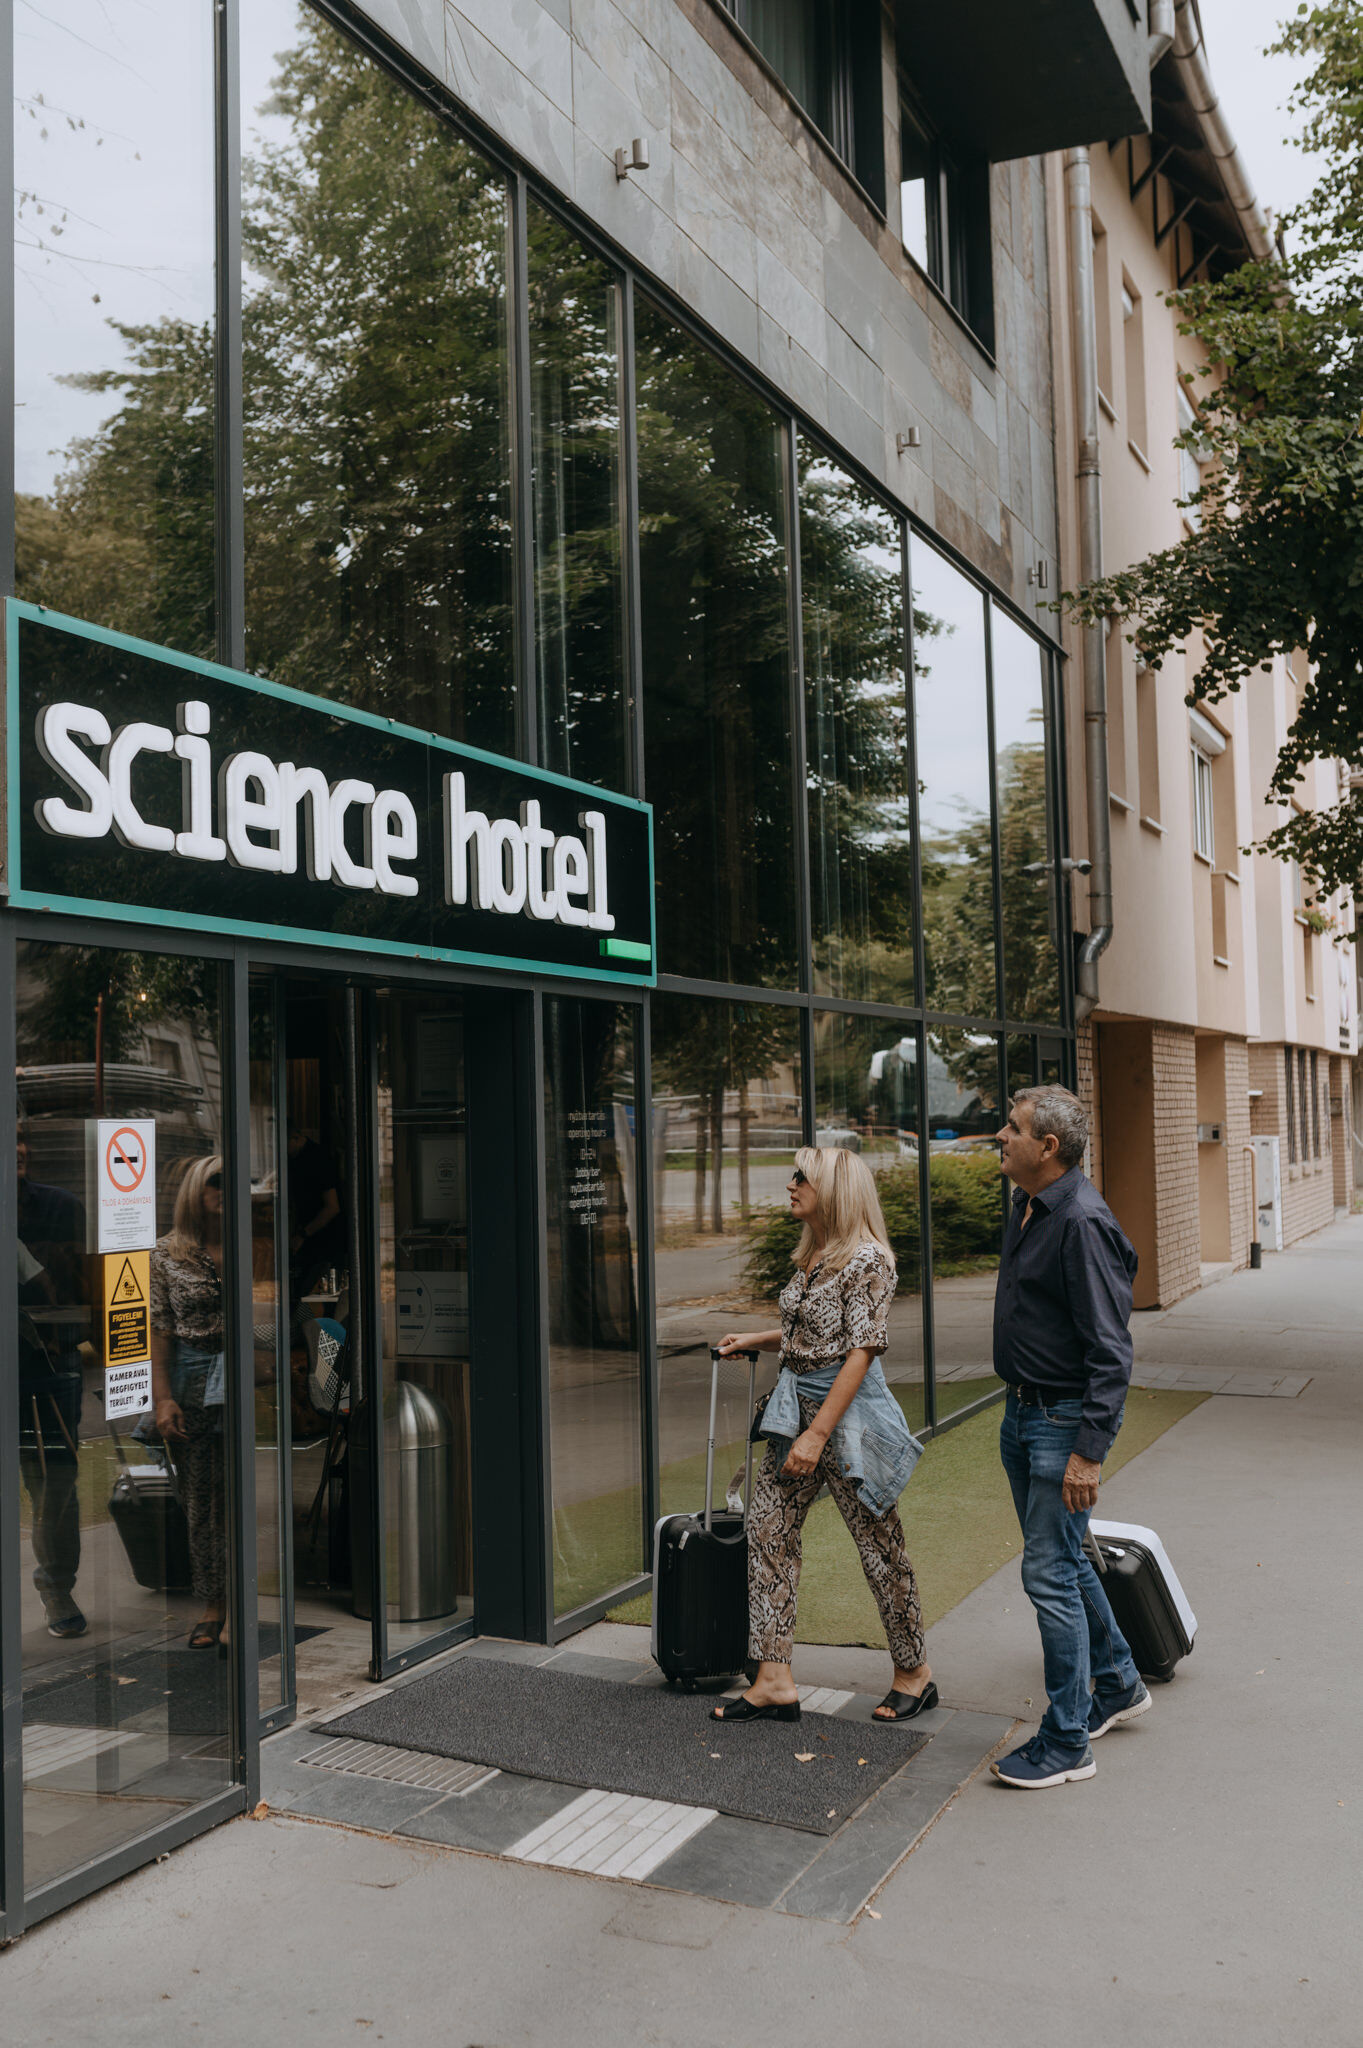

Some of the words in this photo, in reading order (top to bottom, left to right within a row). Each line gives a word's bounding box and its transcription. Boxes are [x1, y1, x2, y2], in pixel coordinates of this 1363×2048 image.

[35, 700, 419, 897] science
[443, 771, 616, 932] hotel
[568, 1127, 590, 1140] opening
[591, 1128, 607, 1138] hours
[569, 1196, 591, 1210] opening
[591, 1196, 608, 1206] hours
[109, 1368, 148, 1382] KAMERÁVAL
[109, 1380, 149, 1395] MEGFIGYELT
[109, 1395, 134, 1408] TERÜLET!
